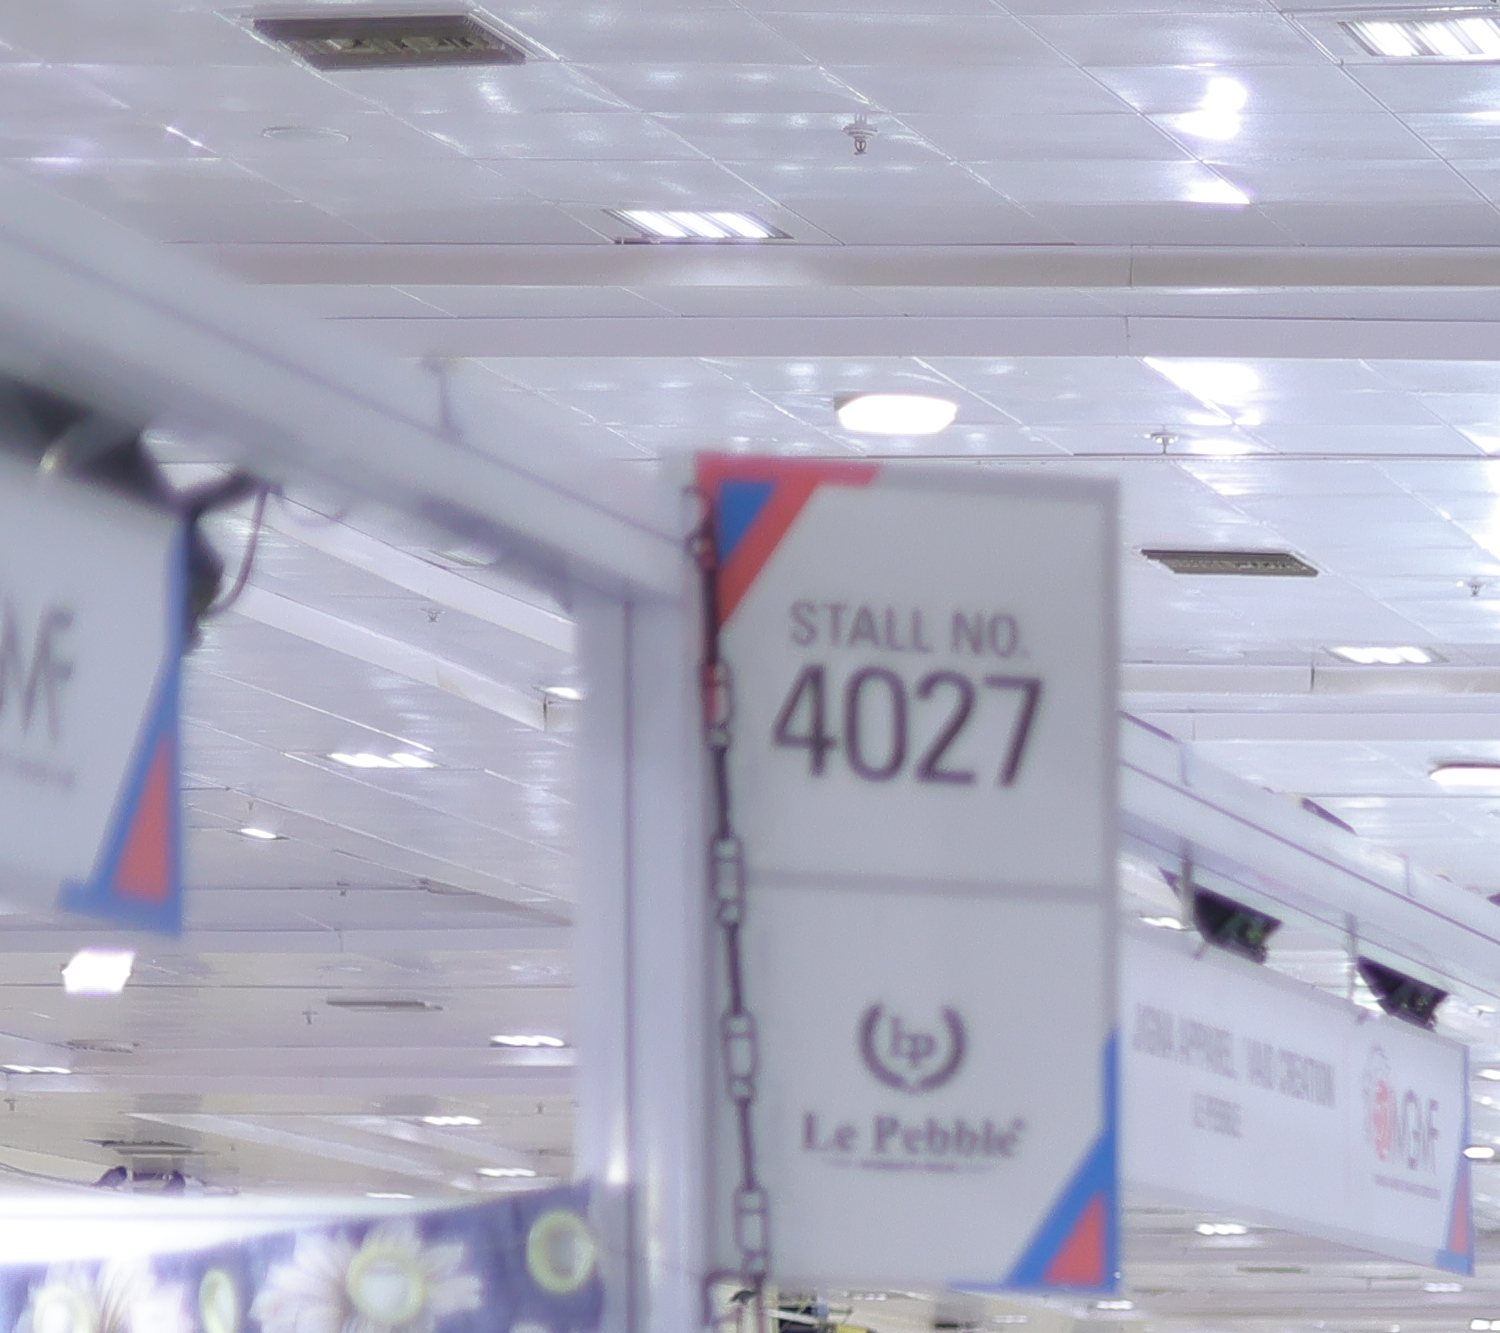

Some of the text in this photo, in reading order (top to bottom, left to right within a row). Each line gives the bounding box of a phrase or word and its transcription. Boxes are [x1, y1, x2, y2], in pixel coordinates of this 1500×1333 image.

[791, 601, 1031, 661] STALL NO.
[772, 664, 1044, 789] 4027
